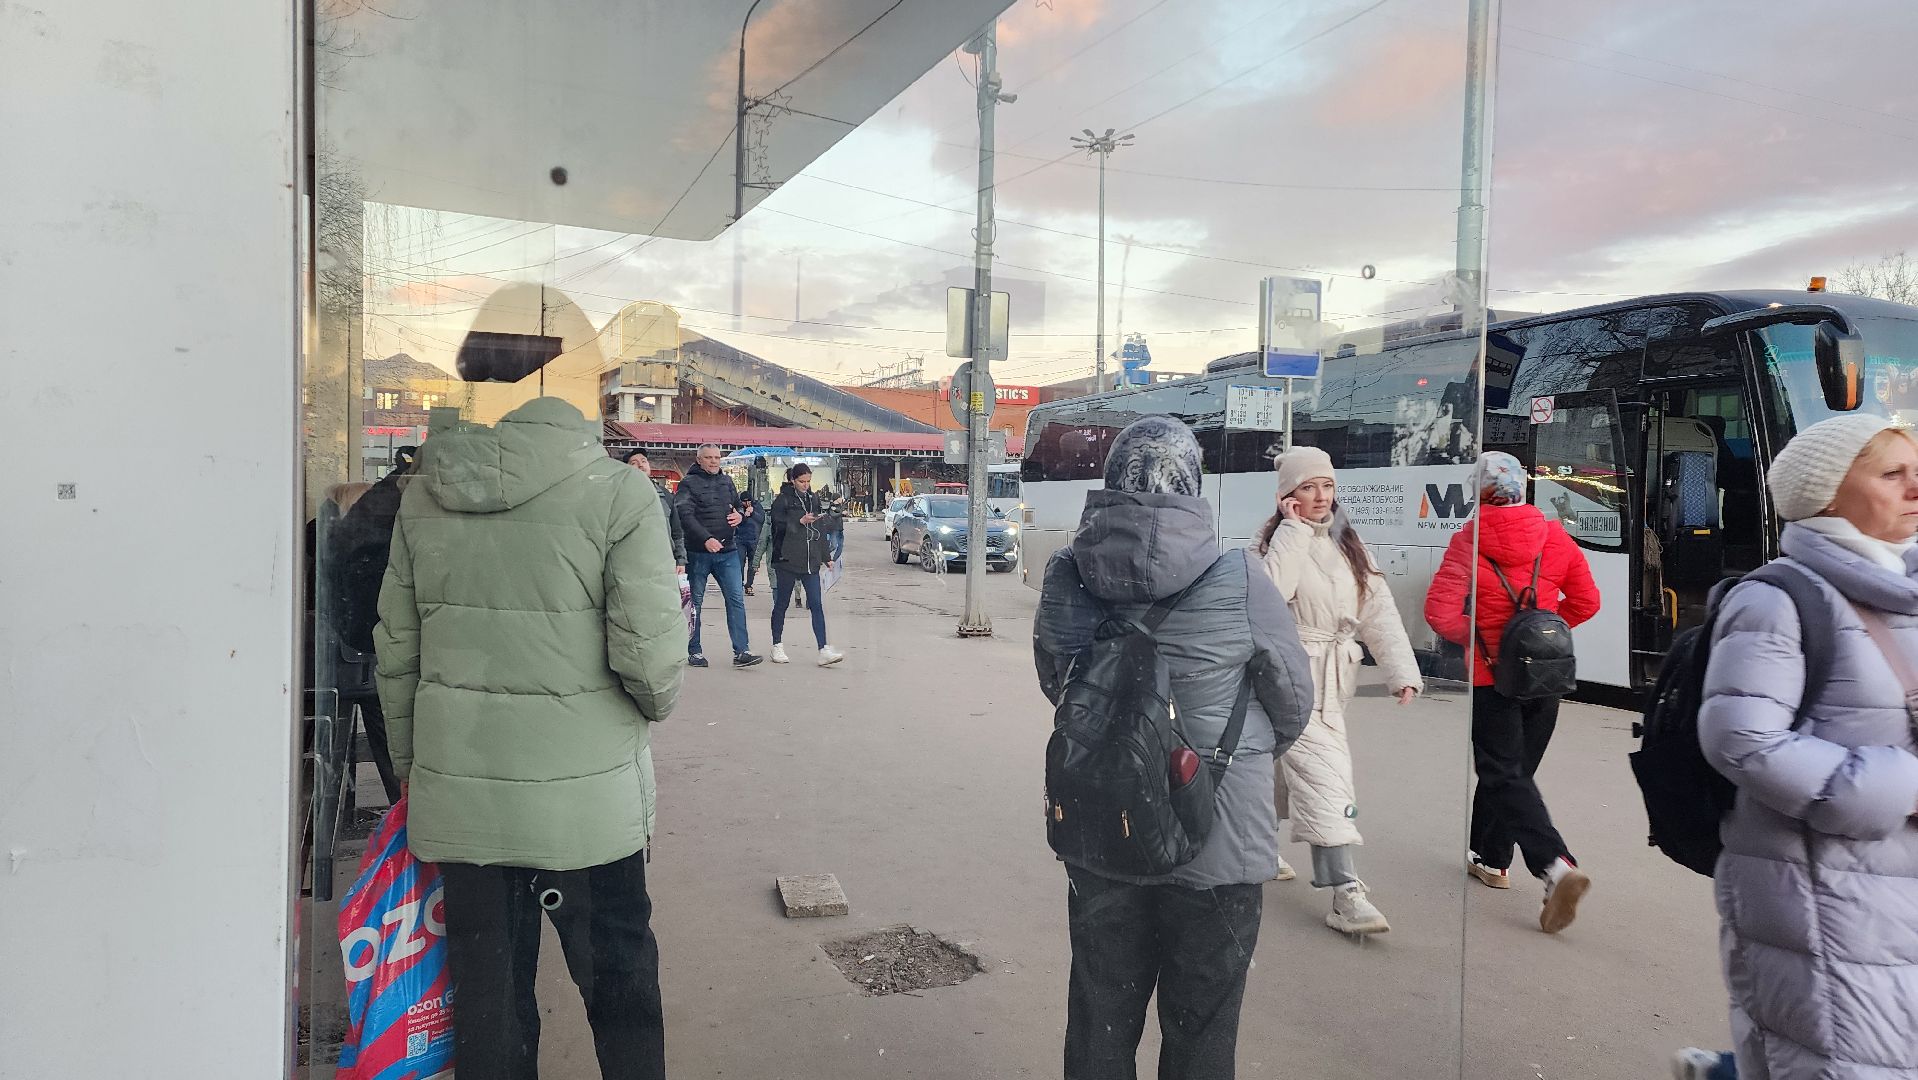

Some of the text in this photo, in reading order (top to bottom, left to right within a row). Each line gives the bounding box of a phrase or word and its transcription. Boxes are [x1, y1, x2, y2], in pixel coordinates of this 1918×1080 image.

[996, 388, 1029, 399] STIC'S
[1347, 485, 1404, 493] ОБСЛУЖИВАНИЕ
[1362, 495, 1404, 504] АВТОБУСОВ
[407, 996, 443, 1016] ozon
